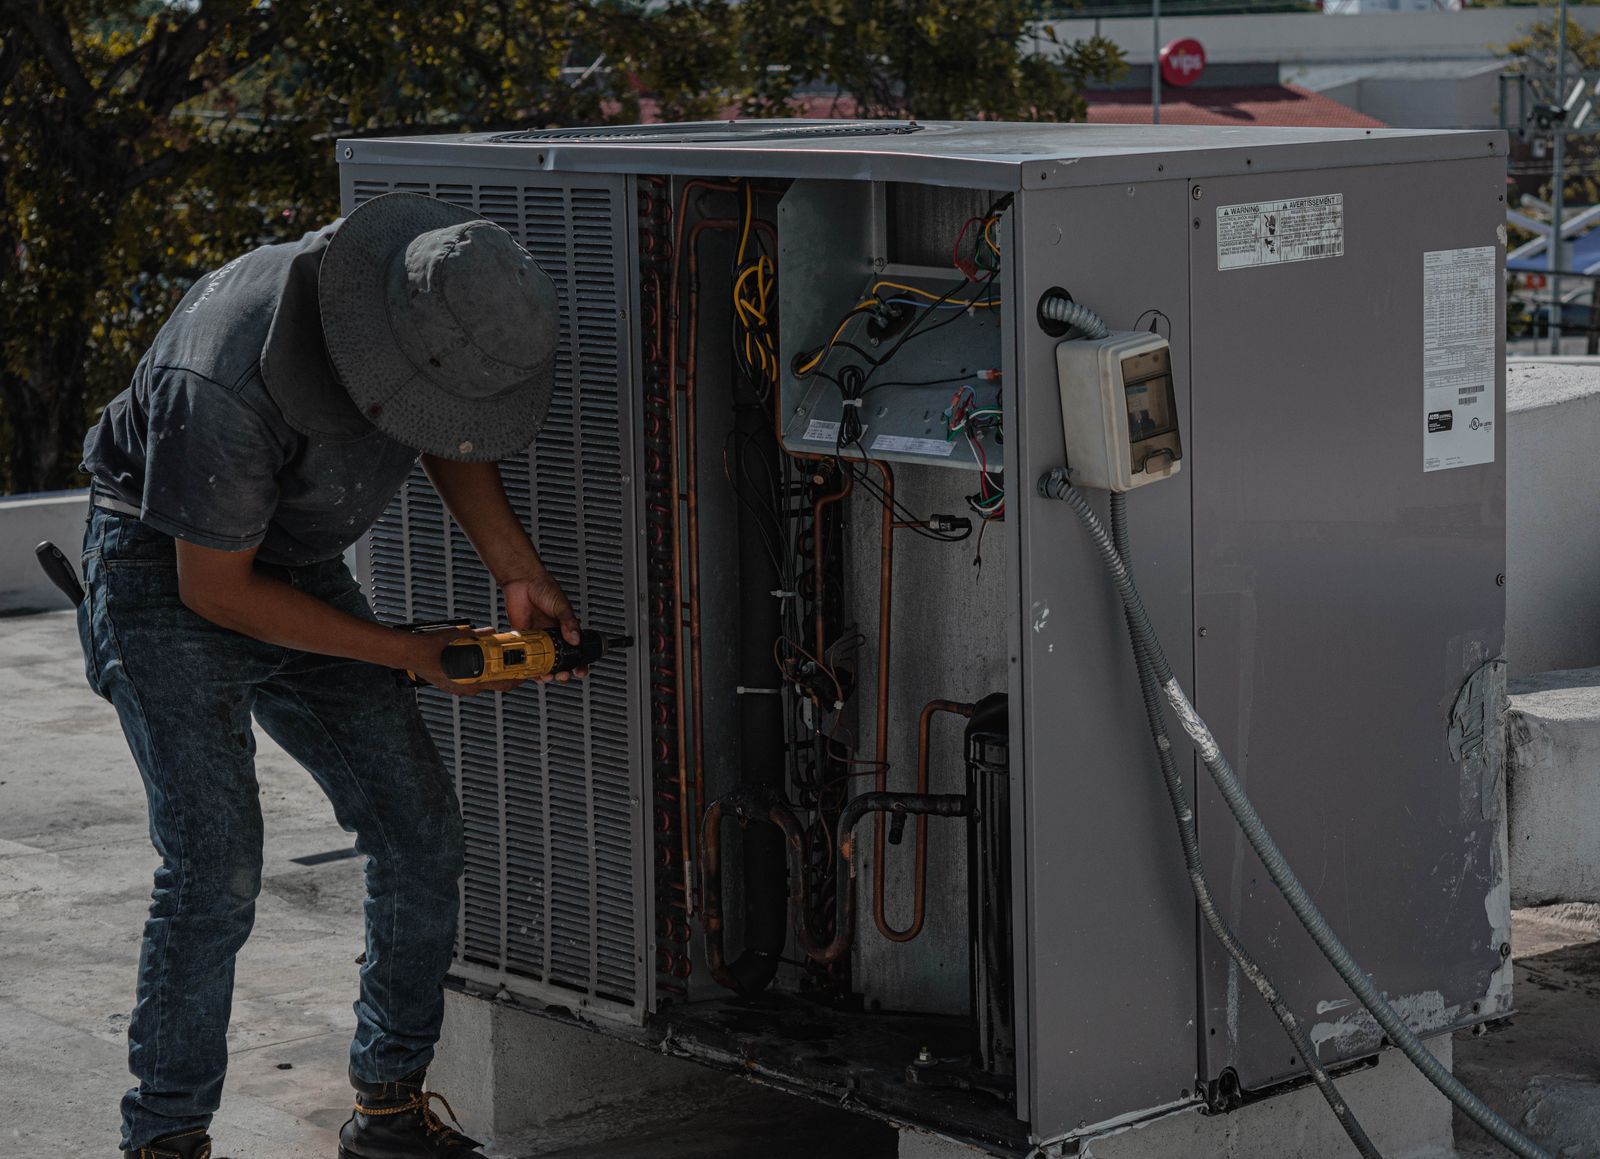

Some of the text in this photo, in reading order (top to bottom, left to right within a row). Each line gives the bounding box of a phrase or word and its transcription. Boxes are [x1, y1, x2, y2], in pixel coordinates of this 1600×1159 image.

[1169, 48, 1202, 76] vips
[1290, 197, 1335, 209] AVERTISSEMENT
[1230, 206, 1260, 215] WARNING
